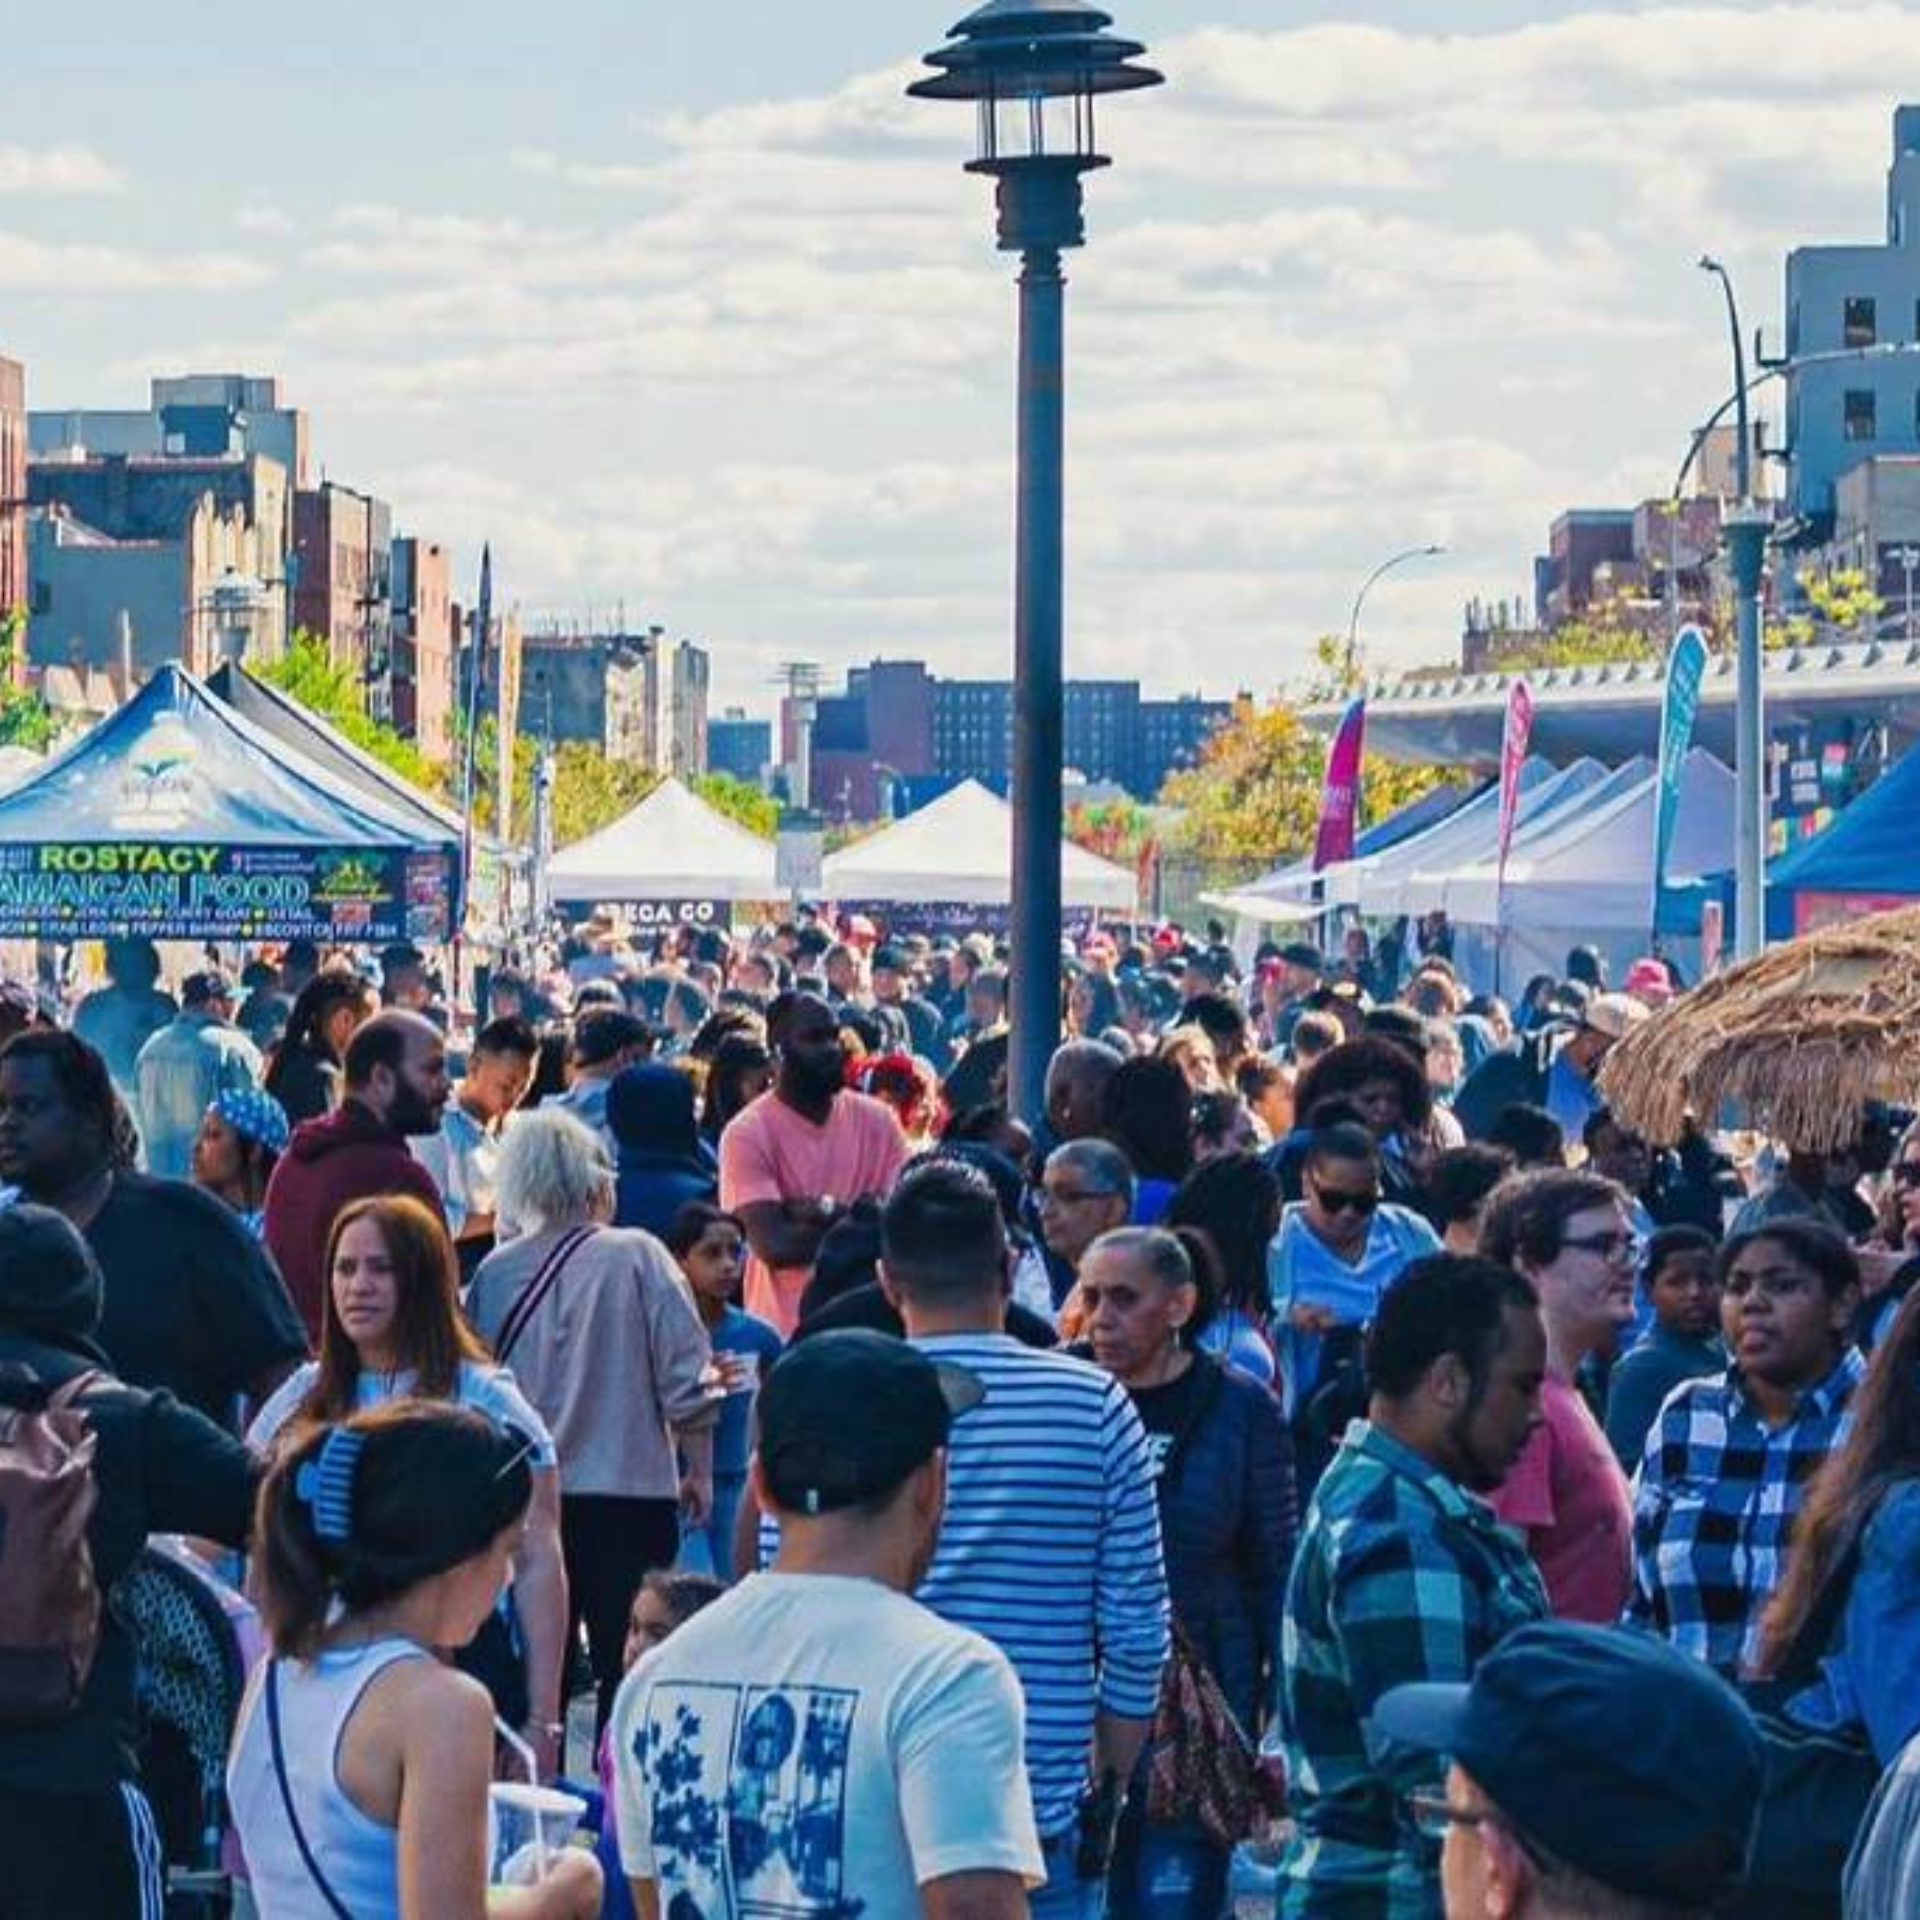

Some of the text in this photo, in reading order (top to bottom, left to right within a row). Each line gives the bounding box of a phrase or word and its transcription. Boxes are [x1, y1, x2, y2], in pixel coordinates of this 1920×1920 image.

[40, 846, 219, 871] ROSTACY
[189, 874, 310, 908] FOOD
[678, 902, 714, 922] GO
